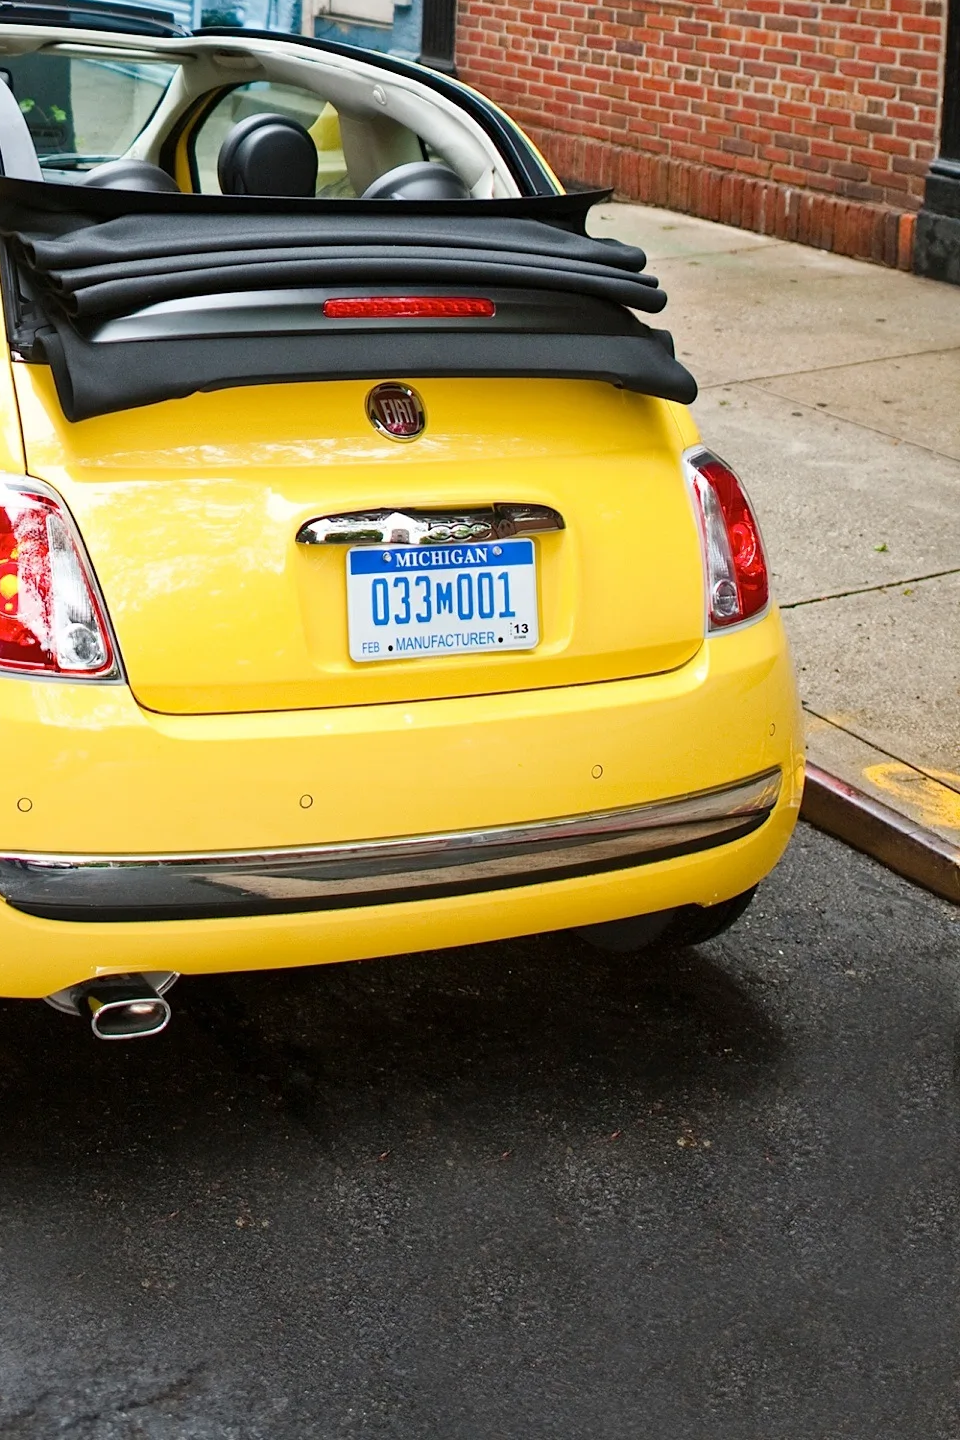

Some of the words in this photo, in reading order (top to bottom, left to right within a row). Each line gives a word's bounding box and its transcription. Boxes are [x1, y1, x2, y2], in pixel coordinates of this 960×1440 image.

[379, 398, 414, 425] FIAT
[395, 547, 488, 567] MICHIGAN
[371, 571, 516, 627] 033M001
[514, 623, 529, 635] 13
[361, 641, 381, 655] FEB
[395, 631, 496, 652] MANUFACTURER
